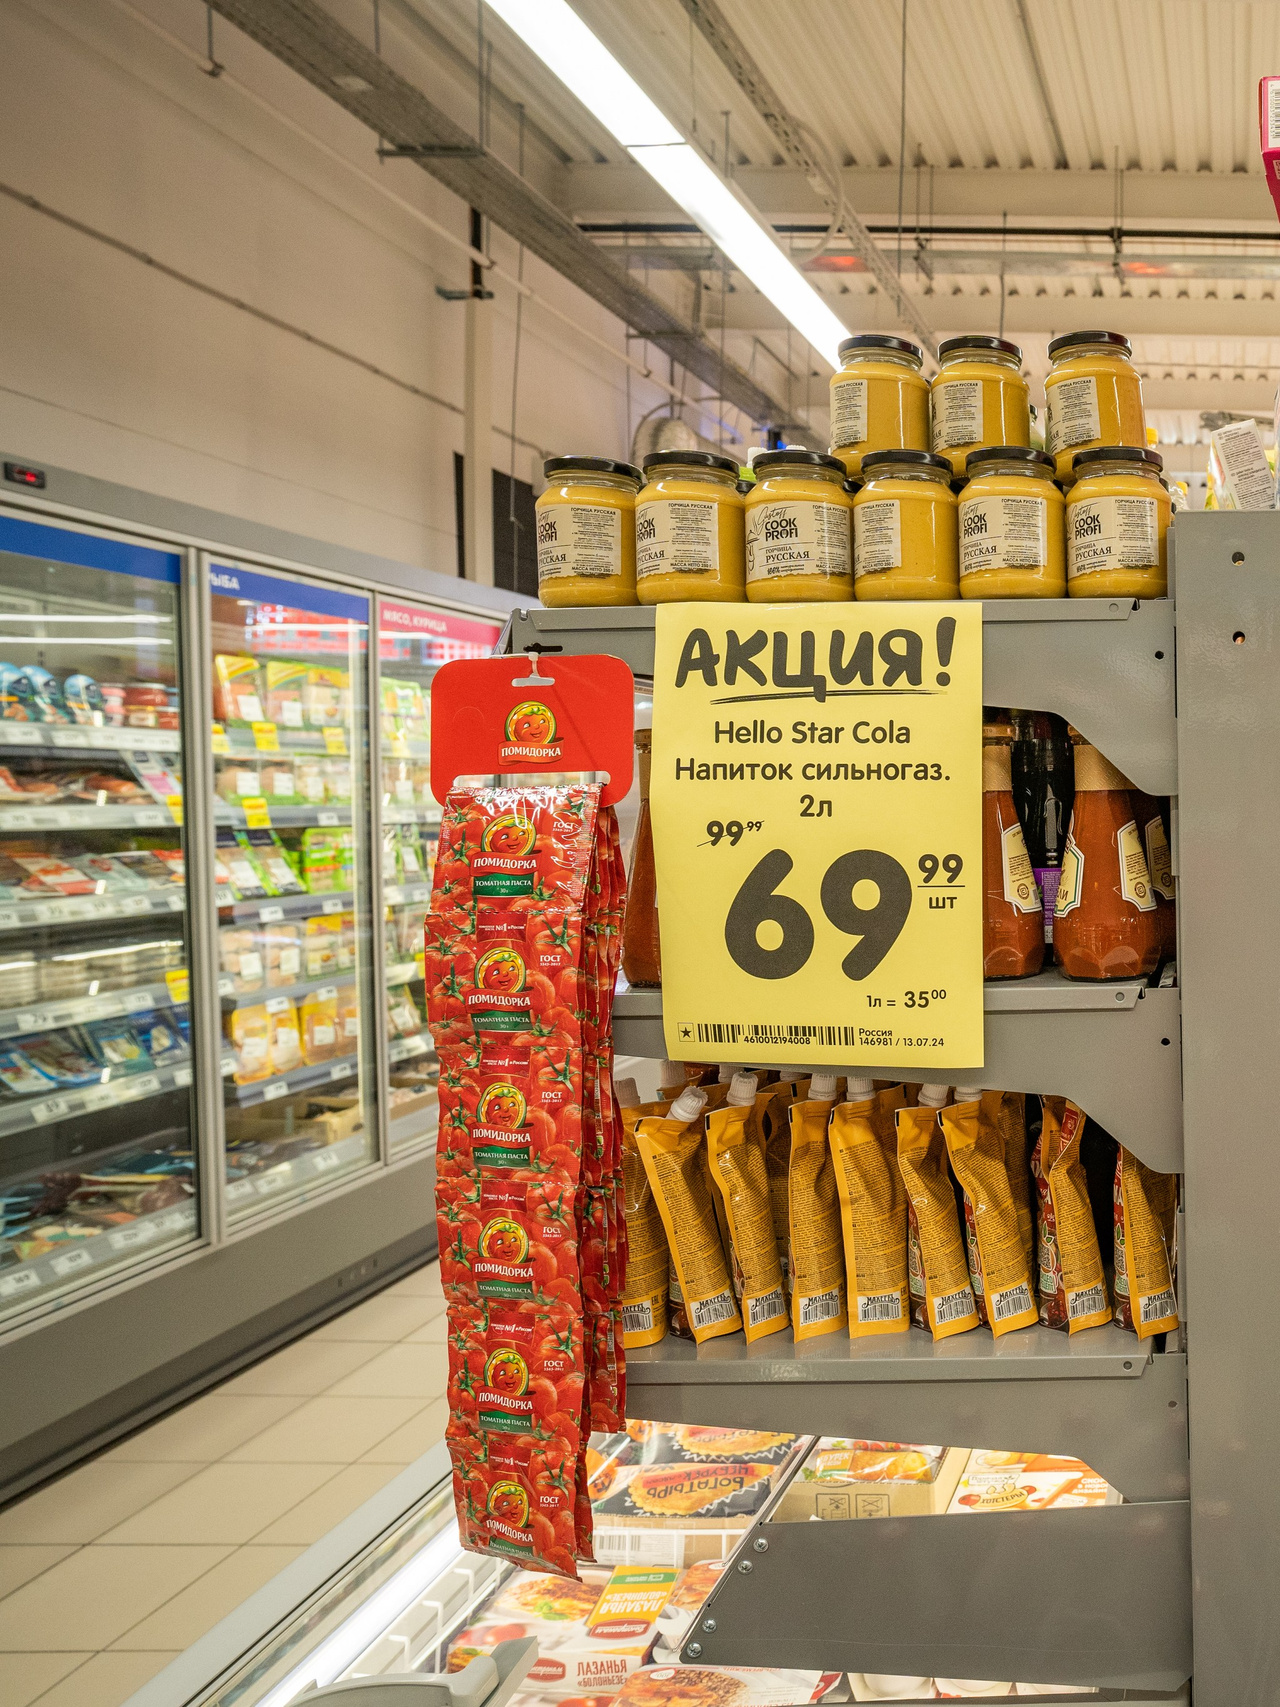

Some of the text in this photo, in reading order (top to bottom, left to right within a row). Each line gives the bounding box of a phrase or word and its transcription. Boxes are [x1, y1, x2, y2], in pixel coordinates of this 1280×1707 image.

[764, 517, 797, 532] COOK
[963, 512, 987, 529] COOK
[1074, 513, 1100, 530] COOK
[765, 527, 798, 542] PROFI
[963, 522, 988, 540] PROFI
[1074, 523, 1102, 540] PROFI
[765, 546, 793, 555] ГОРЧИЦА
[765, 550, 810, 564] РУССКАЯ
[963, 545, 997, 561] РУССКАЯ
[1075, 546, 1112, 561] РУССКАЯ
[382, 607, 448, 636] МЯСО, КУРИЦА
[675, 617, 956, 704] АКЦИЯ!
[715, 720, 910, 743] Hello Star Cola
[500, 742, 562, 759] ПОМИДОРКА
[676, 758, 950, 780] Напиток сильногаз.
[800, 795, 832, 817] 2л
[473, 856, 537, 869] ПОМИДОРКА
[475, 879, 532, 888] ТОМАТНАЯ ПАСТА
[929, 897, 957, 909] шт
[725, 849, 912, 981] 69
[919, 854, 965, 886] 99
[539, 955, 561, 963] ГОСТ
[468, 993, 531, 1007] ПОМИДОРКА
[867, 996, 881, 1007] 1л
[474, 1016, 530, 1024] ТОМАТНАЯ ПАСТА
[859, 1028, 892, 1038] Россия
[860, 1038, 892, 1046] 146981
[903, 1038, 944, 1046] 13.07.24
[497, 1057, 509, 1068] №1
[541, 1091, 563, 1099] ГОСТ
[472, 1128, 532, 1142] ПОМИДОРКА
[474, 1150, 507, 1159] ТОМАТНАЯ
[474, 1262, 534, 1278] ПОМИДОРКА
[479, 1284, 532, 1294] ТОМАТНАЯ ПАСТА
[505, 1323, 516, 1333] №1
[543, 1360, 565, 1368] ГОСТ
[478, 1392, 534, 1411] ПОМИДОРКА
[480, 1415, 531, 1427] ТОМАТНАЯ ПАСТА
[646, 1476, 744, 1500] БОГАТЫРЬ
[539, 1496, 559, 1504] ГОСТ
[980, 1490, 1025, 1505] ХОТСТЕРЫ
[486, 1518, 534, 1543] ПОМИДОРКА
[599, 1594, 662, 1616] ЛАЗАНЬЯ
[576, 1659, 628, 1677] ЛАЗАНЬЯ
